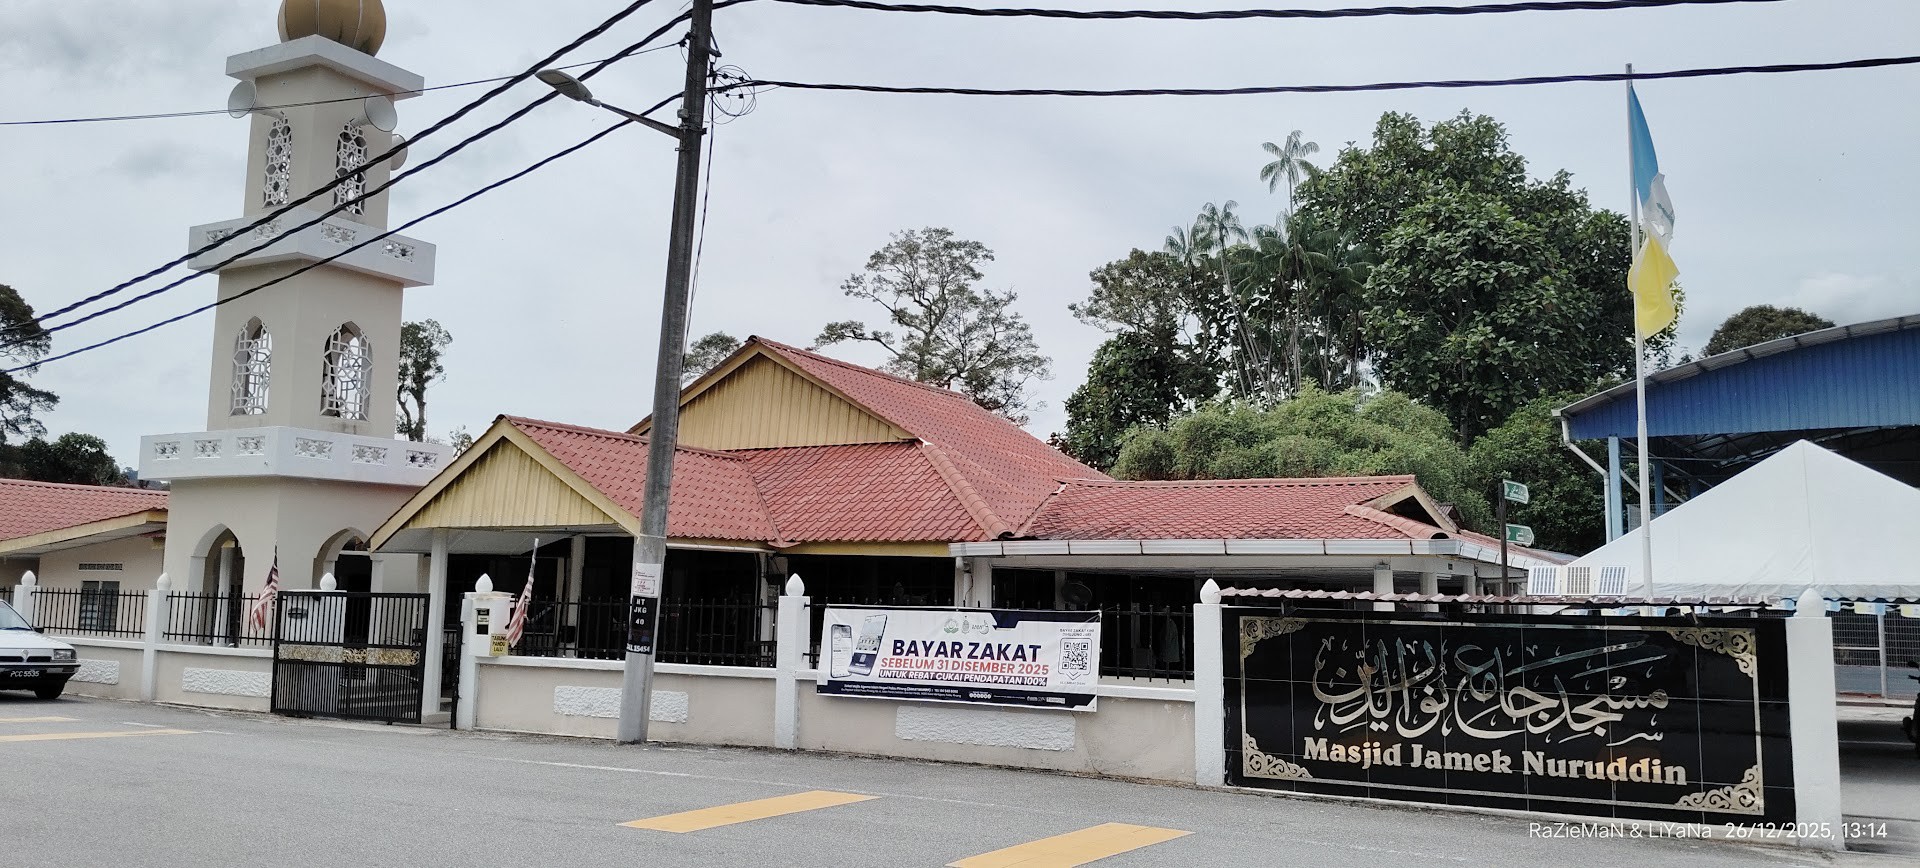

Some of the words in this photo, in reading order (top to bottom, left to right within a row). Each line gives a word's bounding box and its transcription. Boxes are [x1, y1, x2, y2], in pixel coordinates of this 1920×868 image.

[634, 606, 647, 614] JKG
[635, 618, 645, 626] 40
[892, 639, 964, 659] BAYAR
[967, 642, 1042, 663] ZAKAT
[881, 657, 935, 670] SEBELUM
[937, 659, 948, 671] 31
[951, 660, 1016, 674] DISEMBER
[1018, 663, 1049, 676] 2025
[879, 670, 907, 679] UNTUK
[908, 671, 936, 680] REBAT
[936, 673, 963, 682] CUKAI
[964, 674, 1023, 685] PENDAPATAN
[1023, 677, 1047, 687] 100%
[1303, 737, 1402, 770] Masjid
[1411, 743, 1513, 774] Jamek
[1522, 750, 1688, 786] Nuruddin
